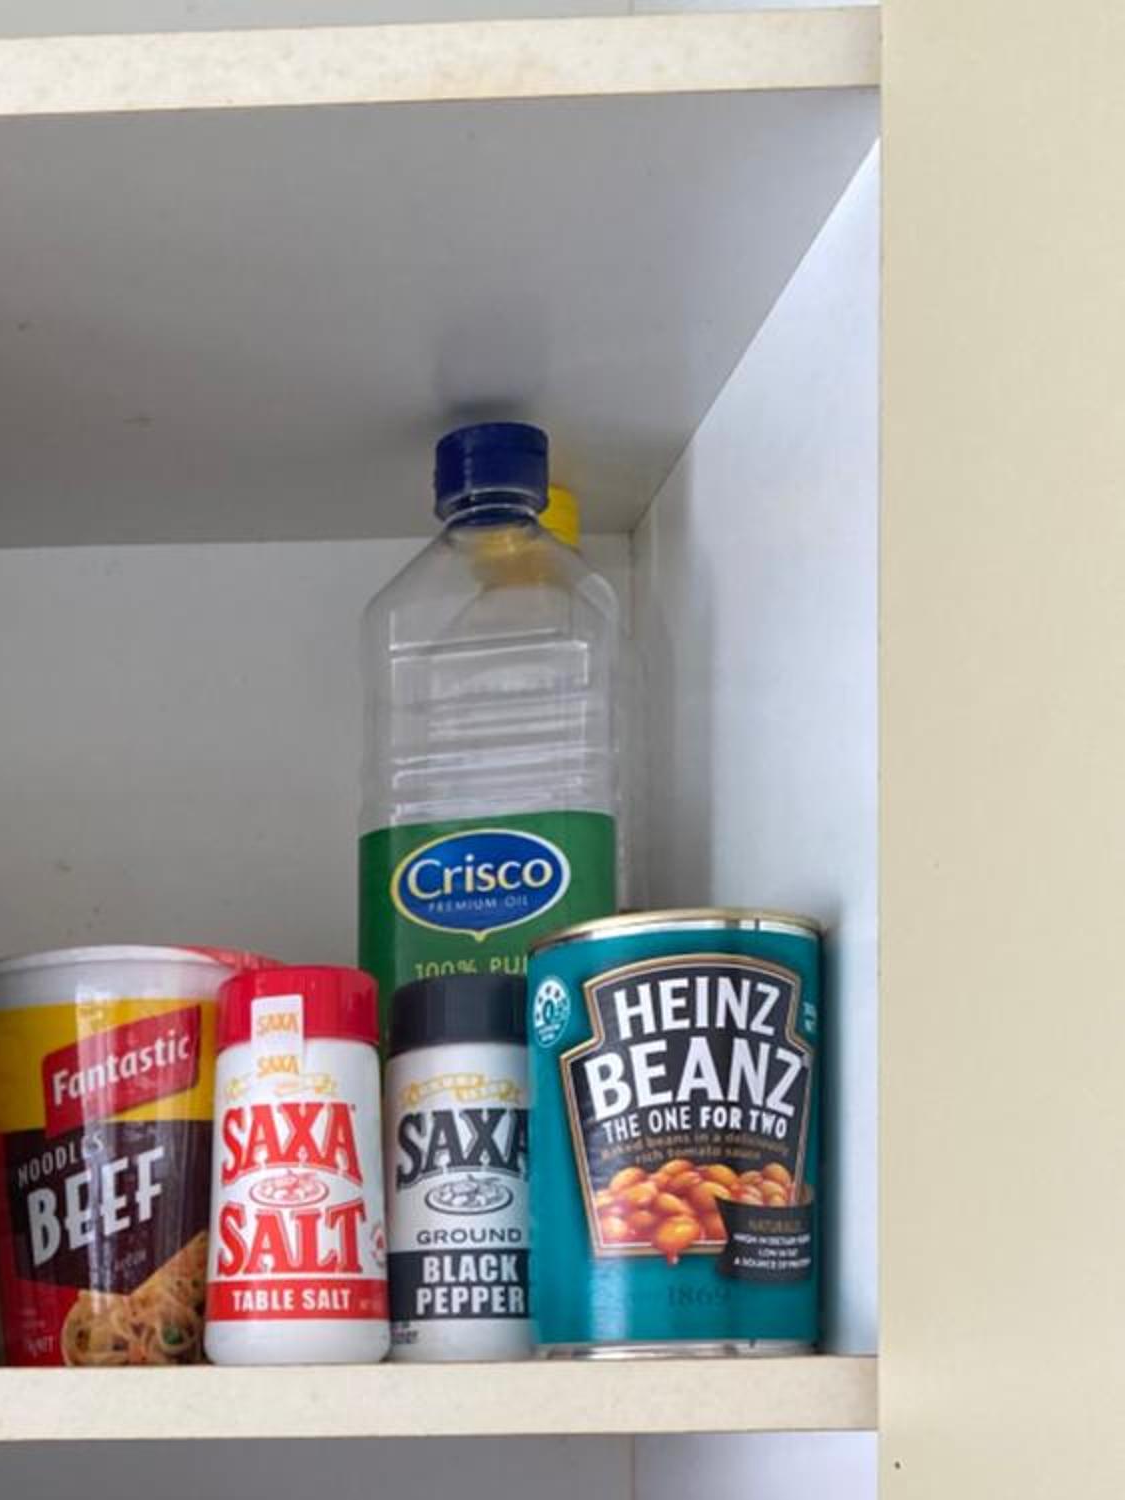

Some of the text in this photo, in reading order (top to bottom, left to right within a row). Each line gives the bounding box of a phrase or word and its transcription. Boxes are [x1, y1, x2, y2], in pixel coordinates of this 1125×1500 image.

[407, 853, 553, 900] Crisco
[429, 897, 497, 913] PREMIUM
[256, 1012, 299, 1035] SAXA
[613, 976, 779, 1040] HEINZ
[52, 1028, 191, 1106] Fantastic
[256, 1055, 300, 1078] SAXA
[586, 1036, 810, 1121] BEANZ
[602, 1106, 788, 1144] THE ONE FOR TWO
[220, 1102, 365, 1187] SAXA
[27, 1146, 165, 1266] BEEF
[218, 1203, 367, 1278] SALT
[416, 1229, 522, 1246] GROUND
[422, 1256, 518, 1283] BLACK
[233, 1290, 294, 1310] TABLE
[301, 1289, 351, 1310] SALT
[416, 1286, 525, 1315] PEPPER
